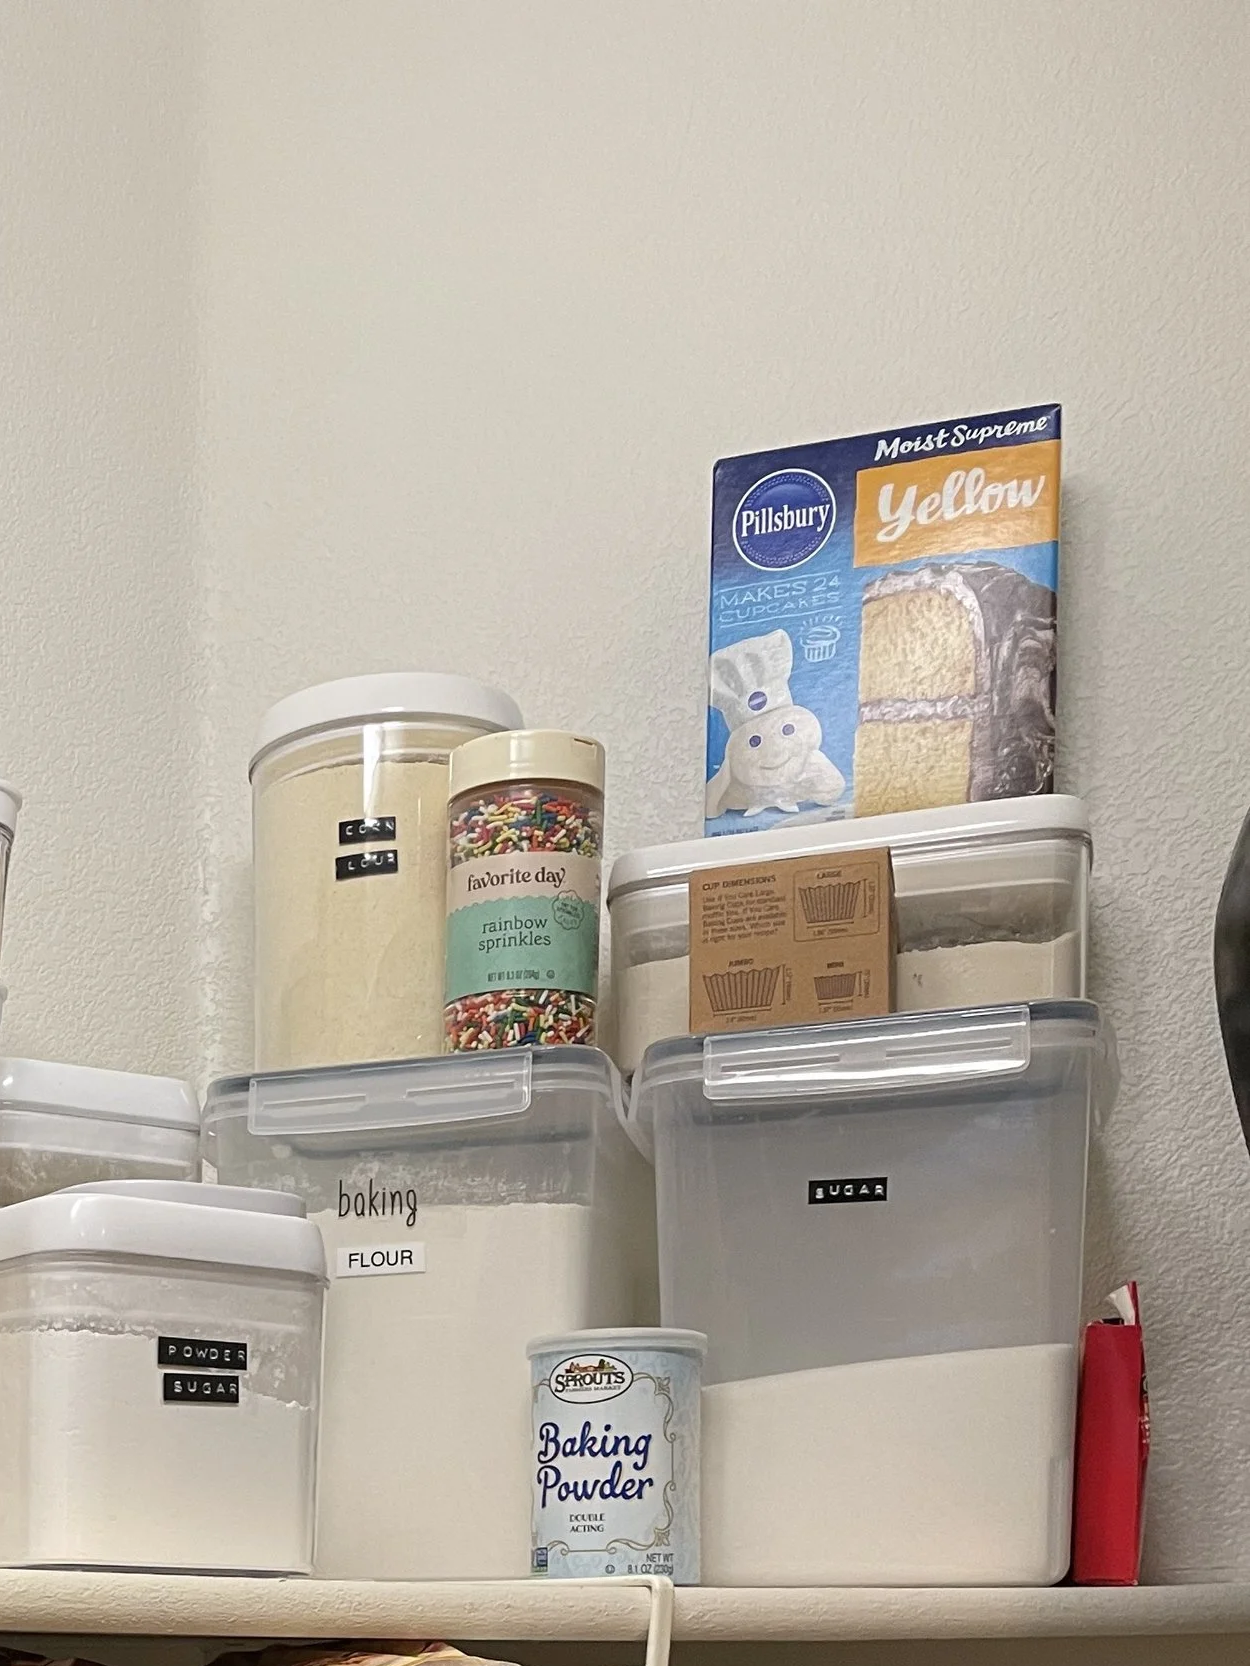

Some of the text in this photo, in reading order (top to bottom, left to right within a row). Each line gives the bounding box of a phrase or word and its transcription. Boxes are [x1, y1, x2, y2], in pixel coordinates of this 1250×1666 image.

[874, 415, 1049, 461] Moist Supreme
[877, 466, 1047, 544] Yellow
[740, 503, 831, 538] Pillsbury
[719, 575, 842, 609] MAKES 24
[718, 592, 841, 622] CUPCAKES
[347, 852, 396, 871] LOUR
[467, 867, 567, 892] favorite day
[482, 915, 549, 934] rainbow
[478, 931, 553, 954] sprinkles
[814, 1182, 886, 1200] SUGAR
[337, 1179, 419, 1227] baking
[347, 1248, 414, 1270] FLOUR
[167, 1343, 248, 1362] POWDER
[173, 1380, 238, 1396] SUGAR
[554, 1371, 626, 1394] SPROUTS
[537, 1420, 653, 1472] Baking
[536, 1460, 655, 1510] Powder
[569, 1513, 606, 1523] DOUBLE
[570, 1524, 605, 1533] ACTING
[640, 1564, 653, 1574] OZ
[646, 1553, 675, 1563] NET WT
